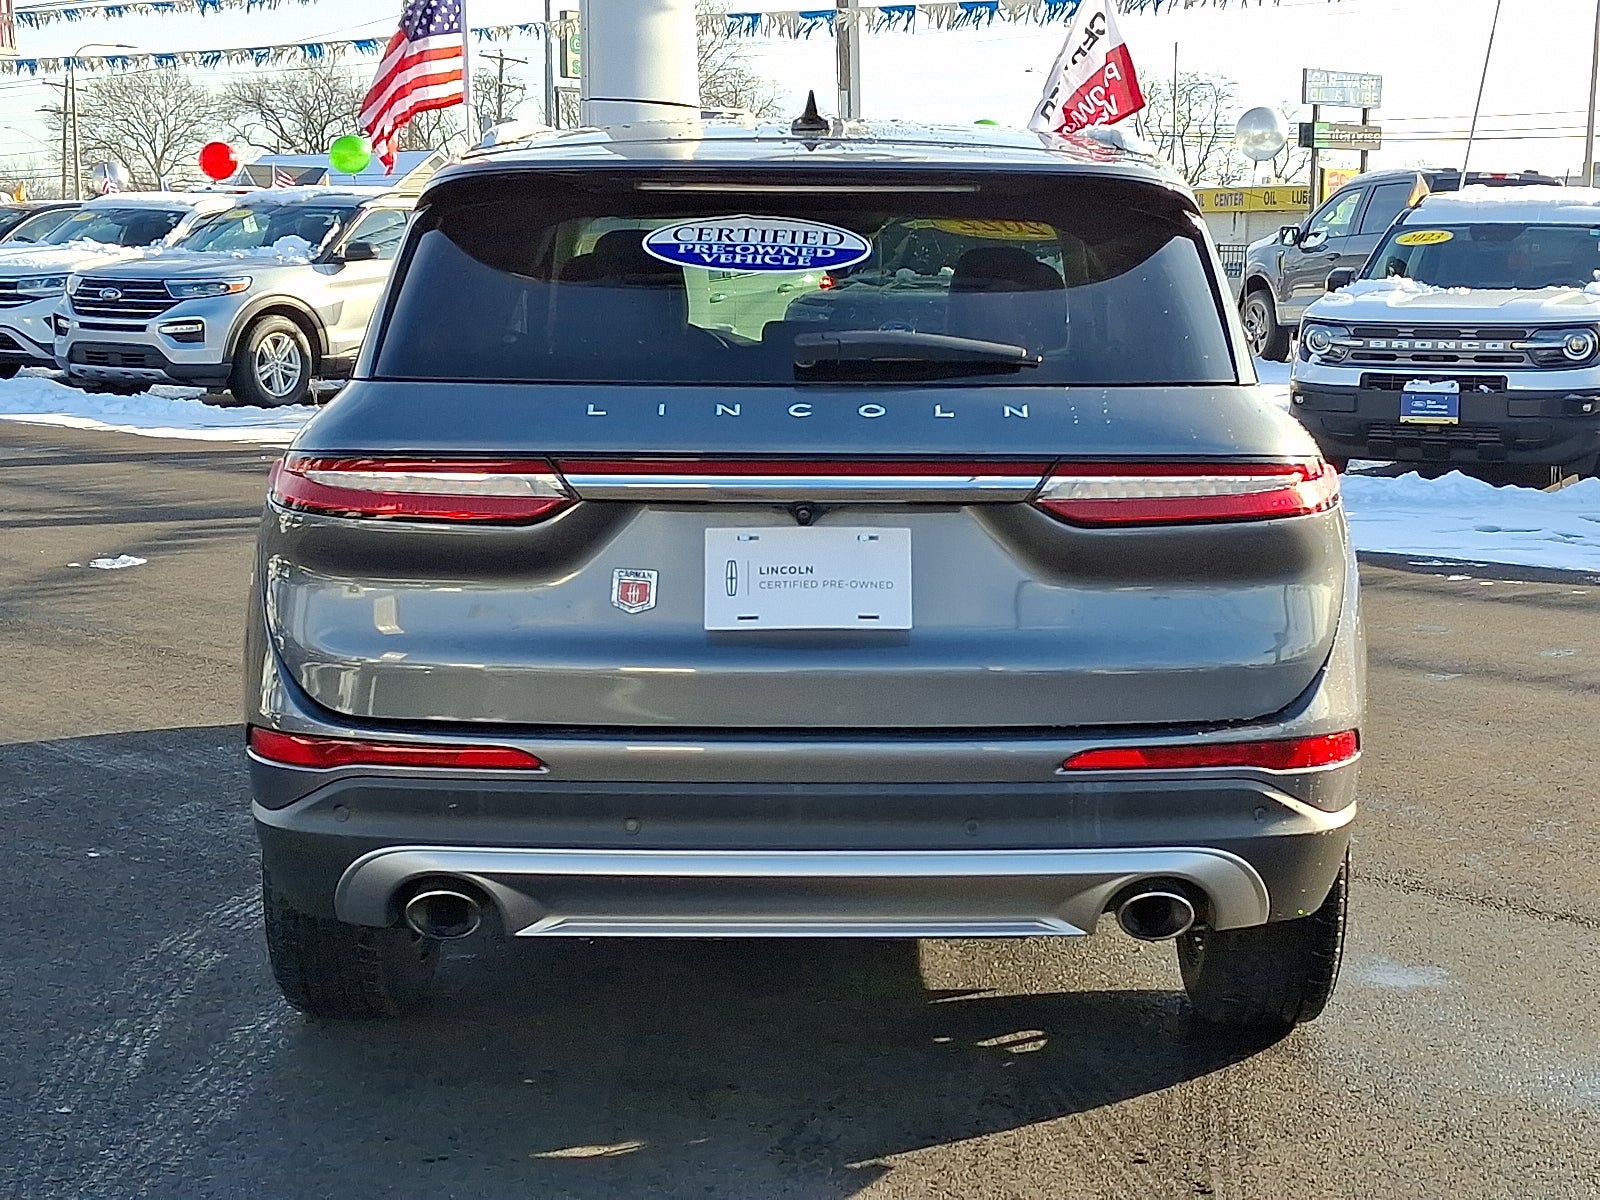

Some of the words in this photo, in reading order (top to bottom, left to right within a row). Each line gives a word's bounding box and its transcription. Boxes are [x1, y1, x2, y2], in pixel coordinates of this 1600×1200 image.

[1311, 71, 1338, 88] CAR
[1214, 191, 1244, 207] CENTER
[1263, 190, 1278, 206] OIL
[672, 226, 845, 246] CERTIFIED
[677, 243, 836, 258] PRE-OWNED
[700, 253, 812, 266] VEHICLE
[1369, 339, 1505, 350] BRONCO
[587, 402, 1030, 420] LINCOLN
[758, 565, 814, 575] LINCOLN
[758, 579, 818, 590] CERTIFIED
[822, 579, 894, 590] PRE-OWNED
